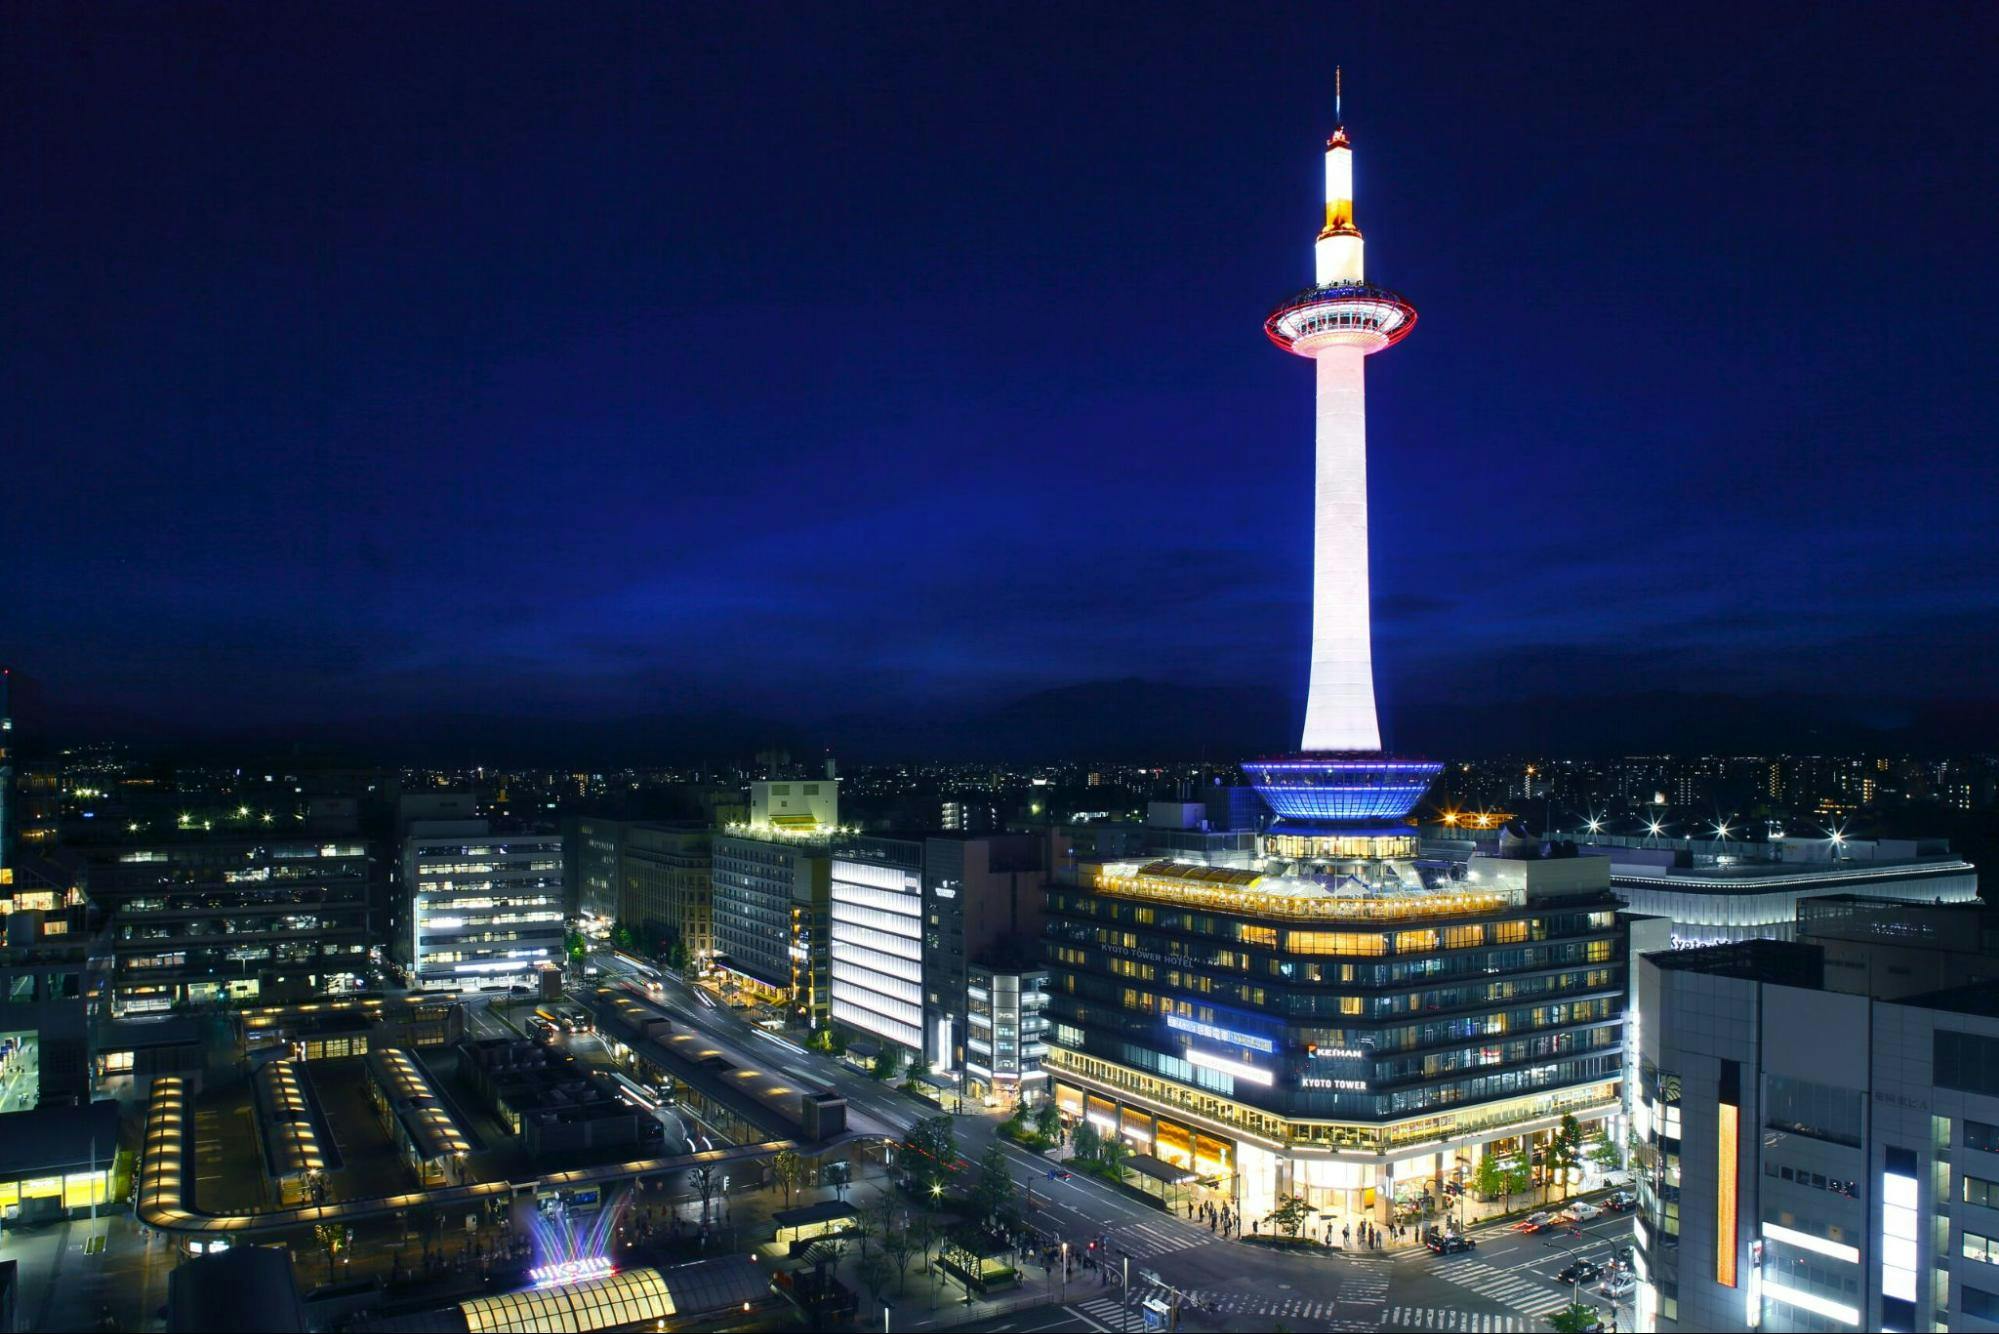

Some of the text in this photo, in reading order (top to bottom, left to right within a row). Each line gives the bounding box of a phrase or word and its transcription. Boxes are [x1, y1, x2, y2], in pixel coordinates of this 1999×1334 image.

[1101, 943, 1193, 968] KYOTO TOWER HOTEL
[1317, 1048, 1362, 1058] KEIHAN
[1302, 1078, 1367, 1090] KYOTO TOWER
